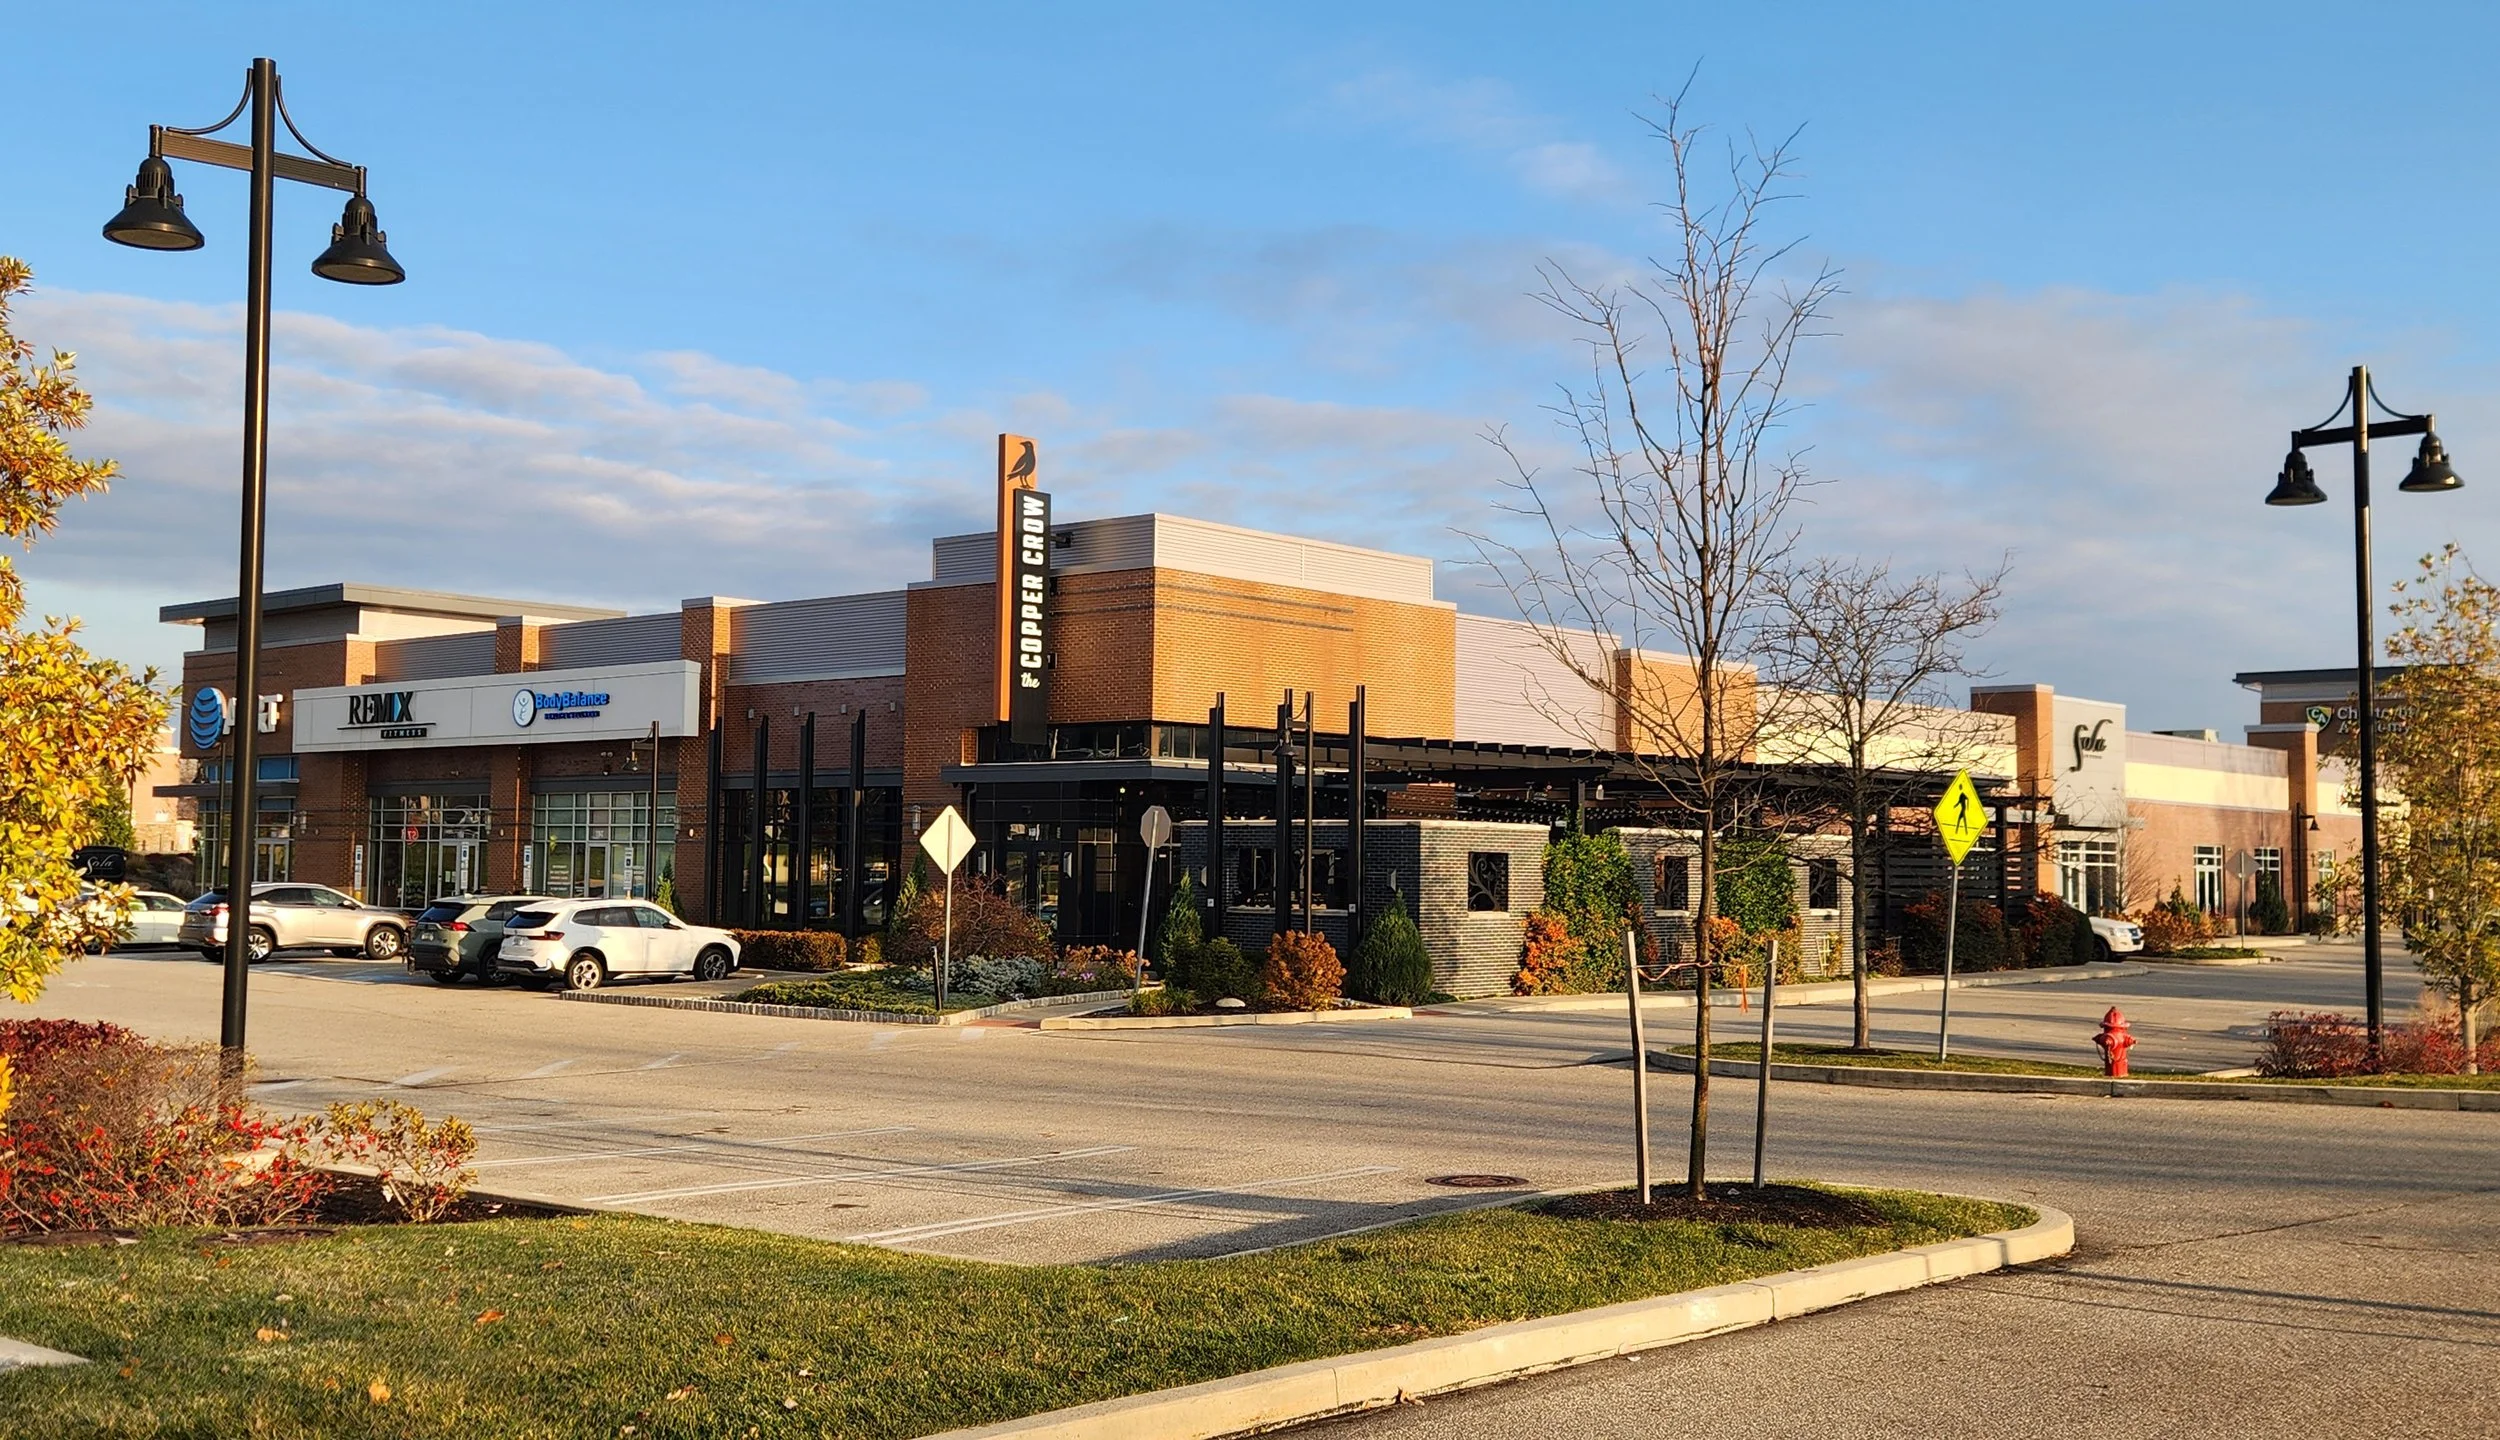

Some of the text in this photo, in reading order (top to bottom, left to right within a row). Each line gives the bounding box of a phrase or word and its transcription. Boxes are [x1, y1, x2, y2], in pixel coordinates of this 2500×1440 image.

[1020, 495, 1045, 689] the COPPER CROW
[347, 691, 414, 725] REMIX
[535, 692, 609, 711] BodyBalance
[383, 729, 422, 738] FITNESS
